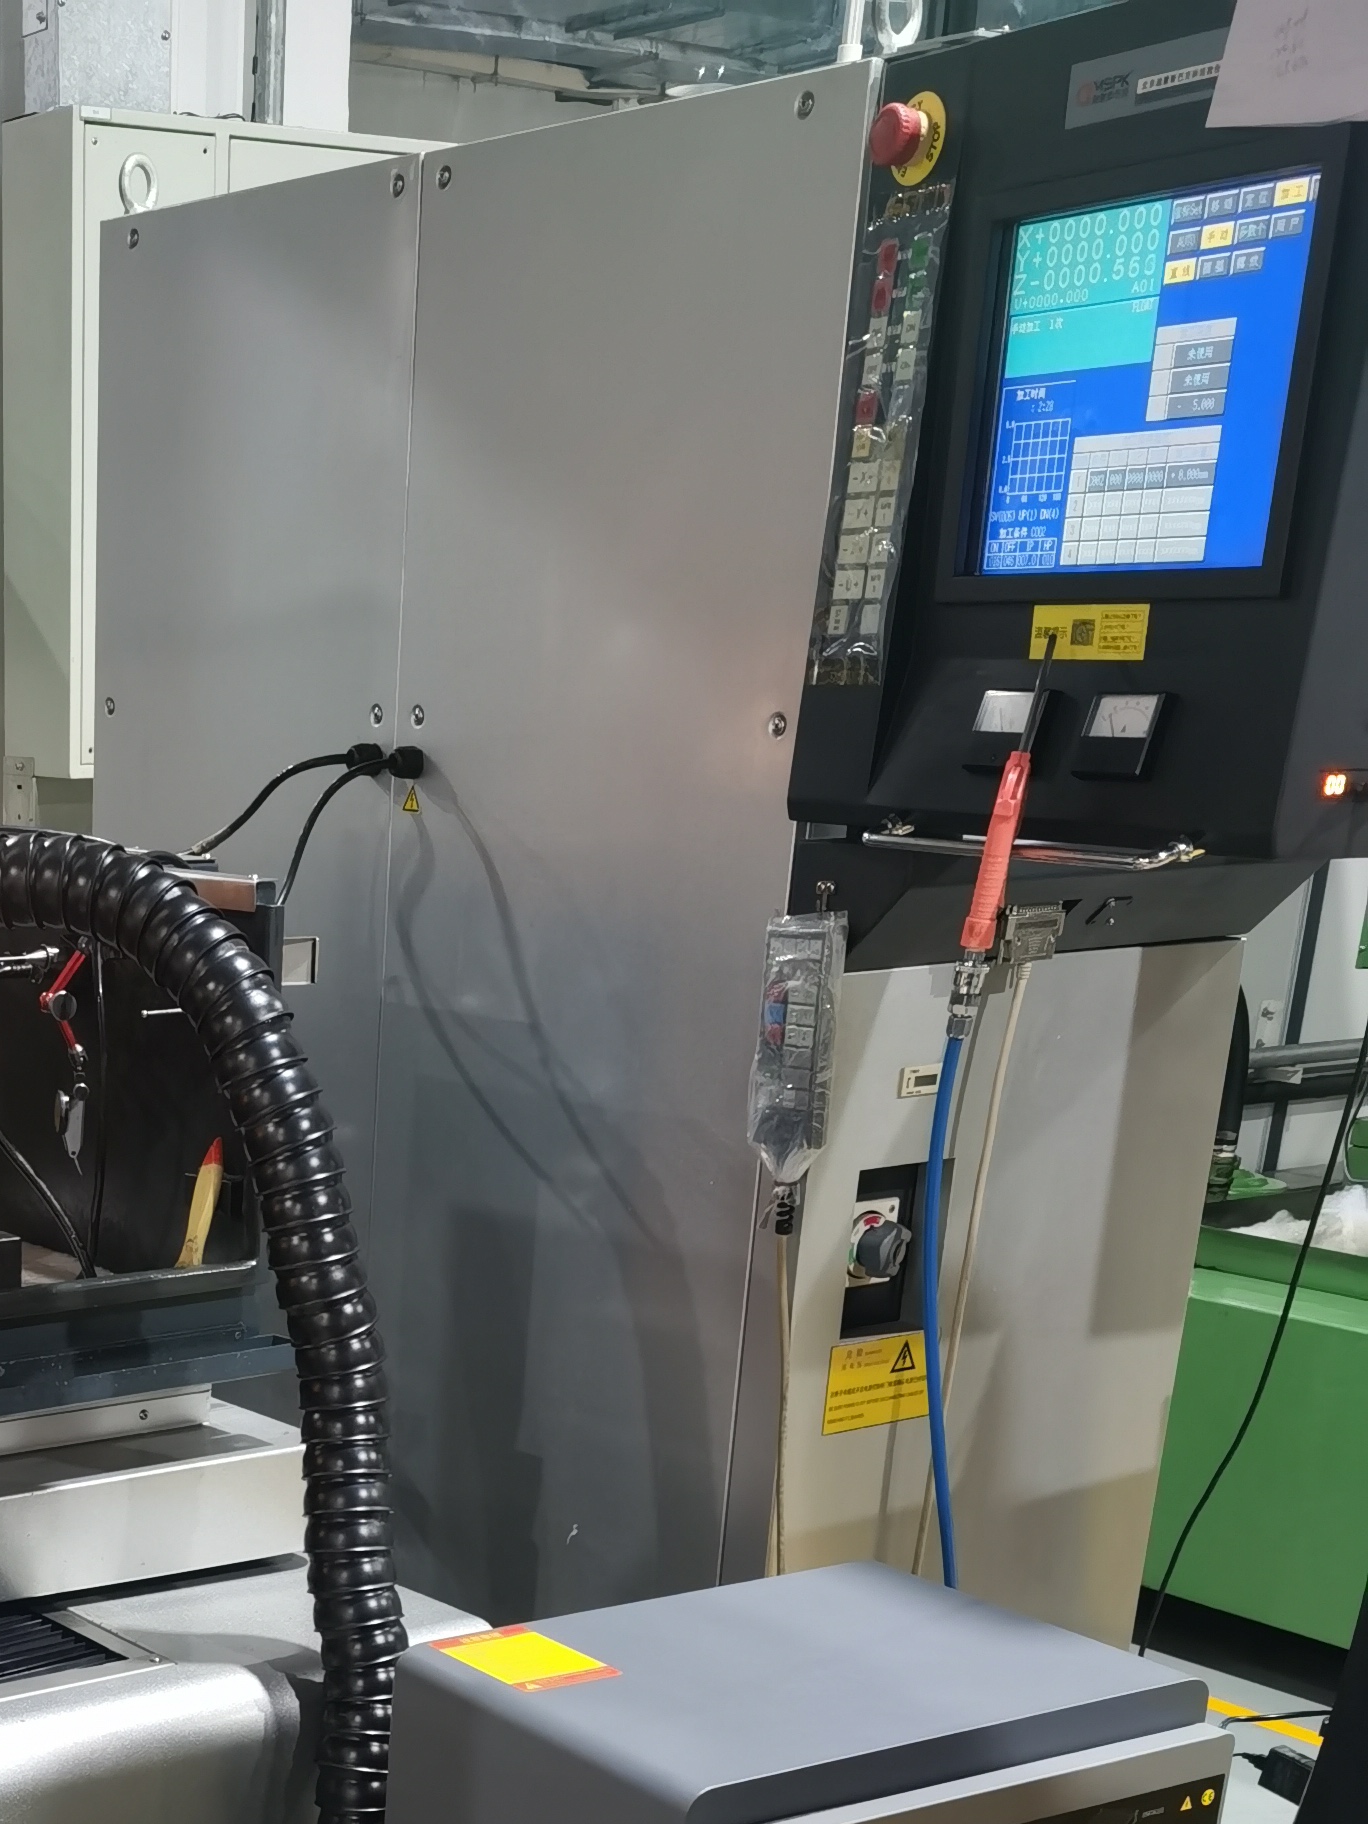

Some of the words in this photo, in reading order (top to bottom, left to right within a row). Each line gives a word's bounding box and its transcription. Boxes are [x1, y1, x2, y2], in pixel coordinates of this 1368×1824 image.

[926, 122, 940, 162] STOP
[1018, 203, 1163, 249] X+0000.000
[1017, 228, 1160, 274] Y+0000.000
